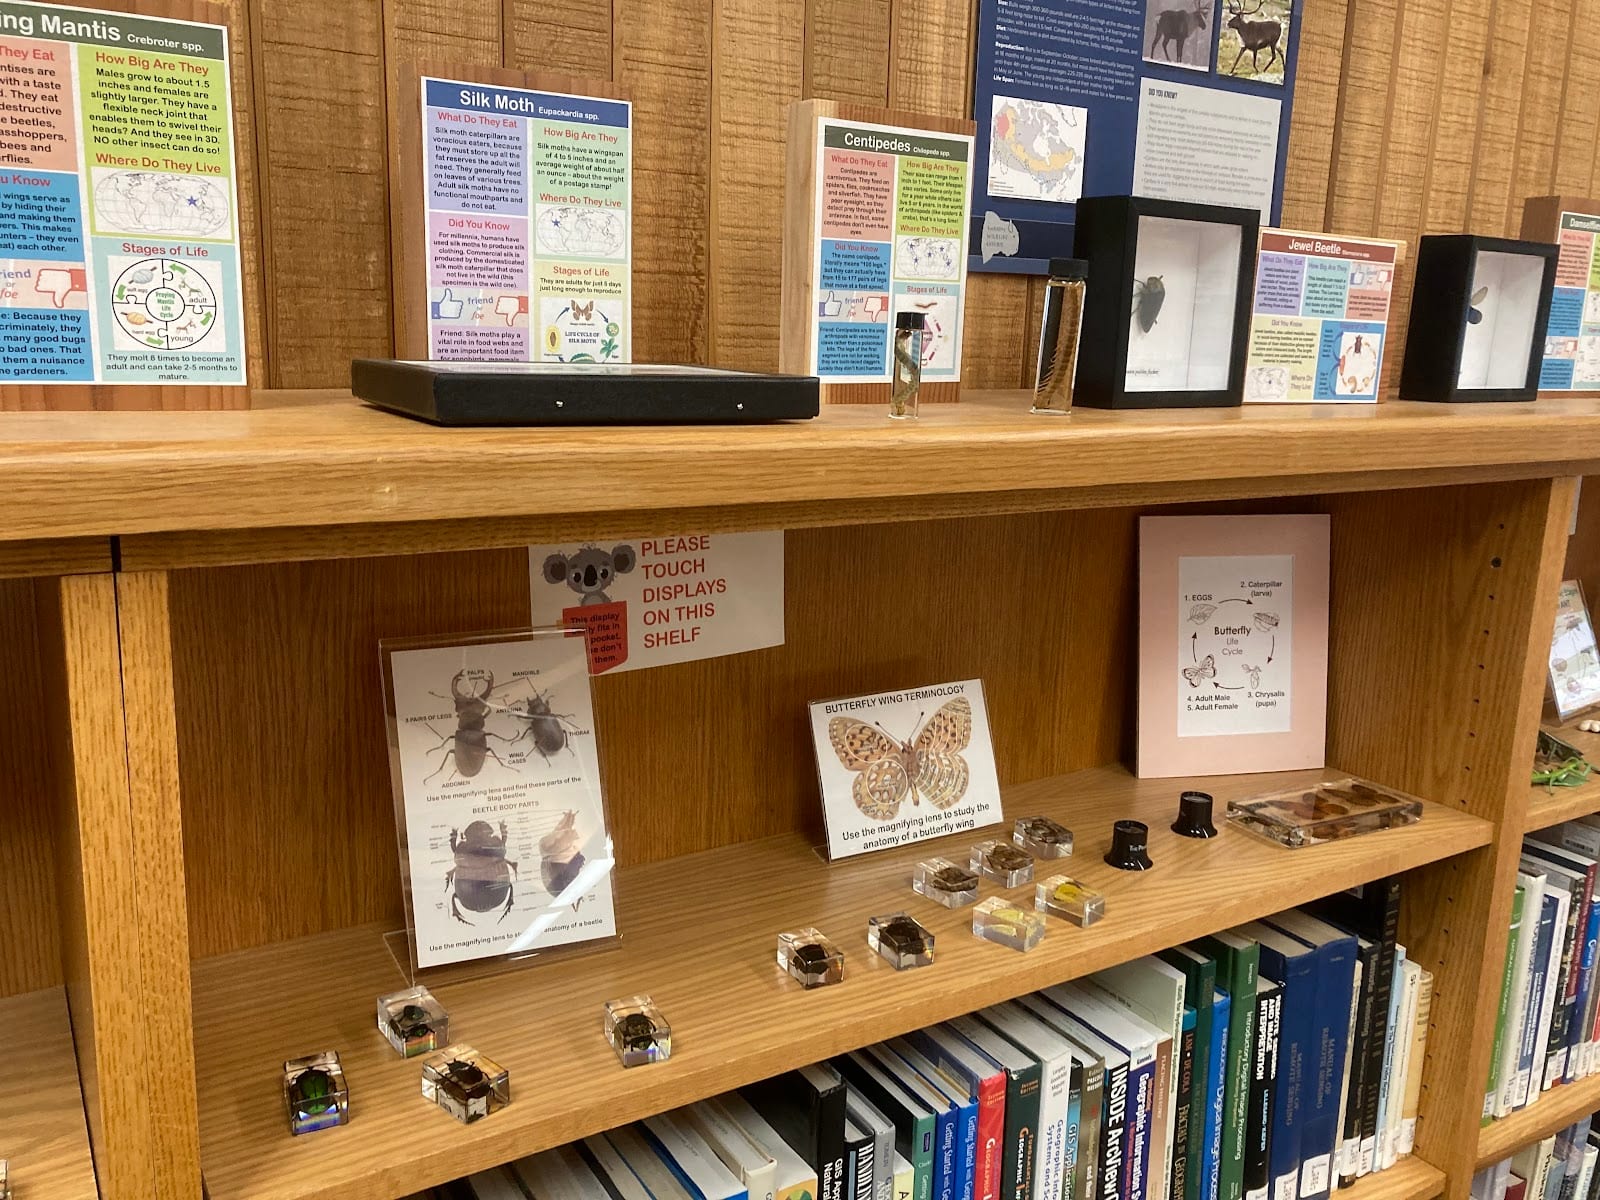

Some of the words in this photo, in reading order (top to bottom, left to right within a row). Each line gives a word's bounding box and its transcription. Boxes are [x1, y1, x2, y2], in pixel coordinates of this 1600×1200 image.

[41, 14, 120, 40] Mantis
[127, 33, 179, 48] Crebroter
[182, 42, 204, 52] spp.
[32, 48, 54, 61] Eat
[95, 51, 124, 64] How
[128, 55, 149, 70] Big
[153, 58, 175, 70] Are
[178, 61, 208, 76] They
[96, 68, 124, 78] Males
[127, 73, 151, 81] grow
[165, 76, 193, 86] about
[195, 79, 209, 88] 1.5
[460, 90, 490, 107] Silk
[495, 94, 534, 112] Moth
[437, 111, 461, 122] What
[463, 114, 476, 123] Do
[478, 115, 500, 128] They
[502, 118, 517, 128] Eat
[538, 106, 583, 118] Eupackardia
[543, 127, 563, 136] How
[565, 129, 579, 140] Big
[581, 131, 596, 140] Are
[598, 132, 617, 144] They
[844, 132, 910, 152] Centipedes
[95, 152, 137, 166] Where
[141, 157, 159, 167] Do
[162, 158, 192, 173] They
[195, 161, 220, 173] Live
[830, 155, 848, 163] What
[848, 156, 858, 164] Do
[860, 157, 875, 167] They
[875, 159, 887, 167] Eat
[906, 160, 920, 168] How
[921, 161, 932, 171] Big
[945, 164, 959, 173] They
[12, 174, 50, 186] Know
[539, 192, 567, 202] Where
[569, 195, 581, 203] Do
[583, 196, 602, 207] They
[604, 198, 621, 207] Live
[448, 218, 463, 227] Did
[465, 219, 482, 228] You
[484, 221, 509, 230] Know
[898, 224, 920, 232] Where
[931, 226, 946, 235] They
[122, 242, 166, 256] Stages
[169, 245, 181, 255] of
[186, 246, 208, 256] Life
[860, 244, 879, 252] Know
[1288, 239, 1313, 252] Jewel
[1313, 240, 1344, 255] Beetle
[553, 266, 581, 276] Stages
[583, 267, 592, 275] of
[594, 268, 609, 276] Life
[906, 285, 927, 294] Stages
[928, 286, 935, 294] of
[936, 286, 947, 294] Life
[641, 535, 709, 556] PLEASE
[641, 558, 704, 579] TOUCH
[643, 578, 726, 602] DISPLAYS
[1240, 581, 1248, 589] 2.
[1184, 594, 1191, 602] 1.
[570, 616, 587, 626] This
[589, 613, 619, 622] display
[643, 608, 669, 625] ON
[674, 602, 714, 620] THIS
[644, 626, 700, 648] SHELF
[1214, 625, 1251, 635] Butterfly
[1220, 647, 1243, 655] Cycle
[1226, 637, 1238, 646] Life
[825, 698, 876, 713] BUTTERFLY
[878, 694, 902, 705] WING
[903, 684, 963, 701] TERMINOLOGY
[1254, 690, 1284, 698] Chrysalis
[507, 756, 527, 765] CASES
[451, 789, 487, 798] magnifying
[487, 794, 502, 802] Stag
[472, 805, 497, 813] BEETLE
[517, 800, 539, 808] PARTS
[842, 830, 860, 841] Use
[862, 827, 876, 837] the
[877, 818, 924, 833] magnifying
[925, 814, 942, 824] lens
[944, 811, 952, 819] to
[953, 806, 975, 818] study
[976, 803, 989, 811] the
[863, 835, 900, 850] anatomy
[901, 831, 910, 841] of
[919, 822, 954, 837] butterfly
[955, 819, 975, 830] wing
[1367, 953, 1378, 992] Remote
[1268, 997, 1276, 1014] AND
[1273, 995, 1282, 1035] REMOTE
[1362, 996, 1373, 1036] Sensing
[1242, 1010, 1252, 1061] Introductory
[1256, 998, 1268, 1080] INTERPRETATION
[1264, 1013, 1275, 1054] IMAGE
[1318, 1027, 1330, 1066] REMOTE
[1325, 1036, 1336, 1081] MANUAL
[1240, 1062, 1248, 1090] Digital
[1108, 1065, 1129, 1127] INSIDE
[1316, 1065, 1328, 1109] SENSING
[1325, 1081, 1331, 1096] OF
[1136, 1072, 1150, 1132] Geographic
[1237, 1091, 1249, 1118] Image
[1177, 1103, 1189, 1143] FRACTALS
[943, 1122, 954, 1149] Getting
[1235, 1118, 1245, 1161] Processing
[942, 1148, 952, 1175] Started
[985, 1138, 996, 1196] GEOGRAPHIC
[1016, 1128, 1029, 1185] GEOGRAPHIC
[1104, 1127, 1123, 1196] ArcView
[1132, 1132, 1146, 1191] Information
[834, 1158, 843, 1178] GIS
